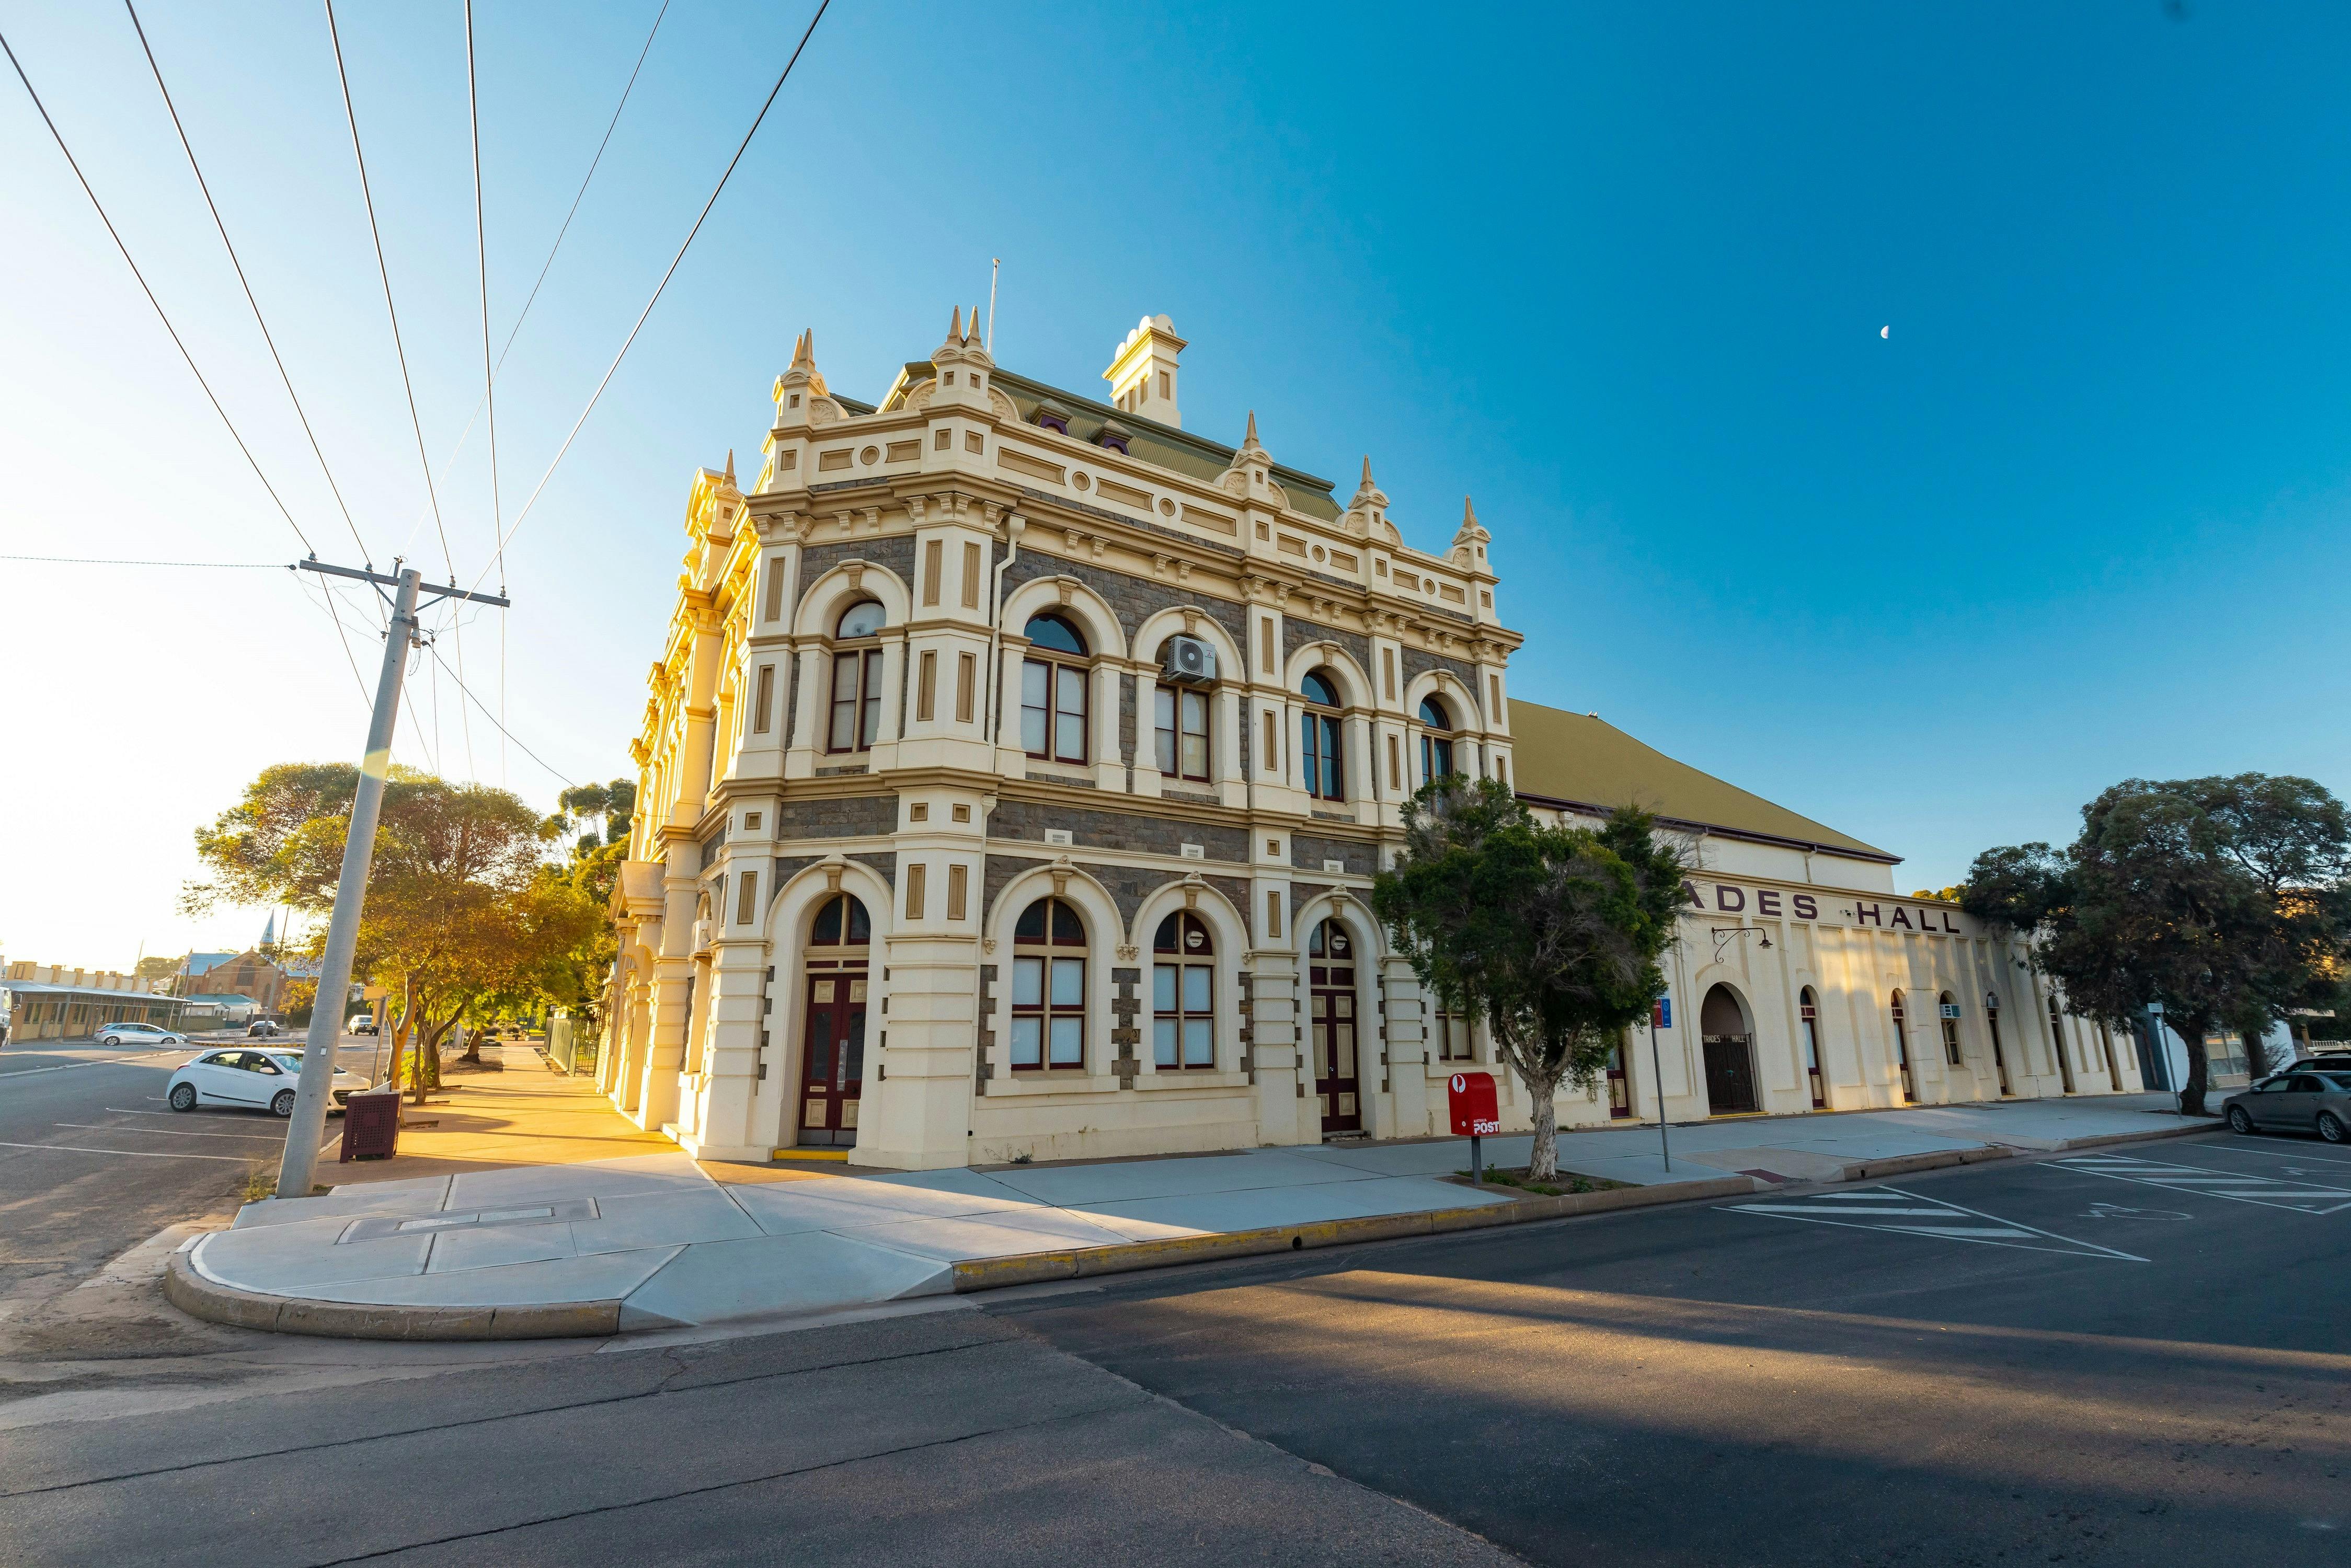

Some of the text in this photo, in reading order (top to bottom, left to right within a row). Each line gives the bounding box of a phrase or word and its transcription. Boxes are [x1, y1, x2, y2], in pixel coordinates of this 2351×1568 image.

[1680, 880, 1960, 934] ADES HALL
[1474, 1121, 1499, 1134] POST
